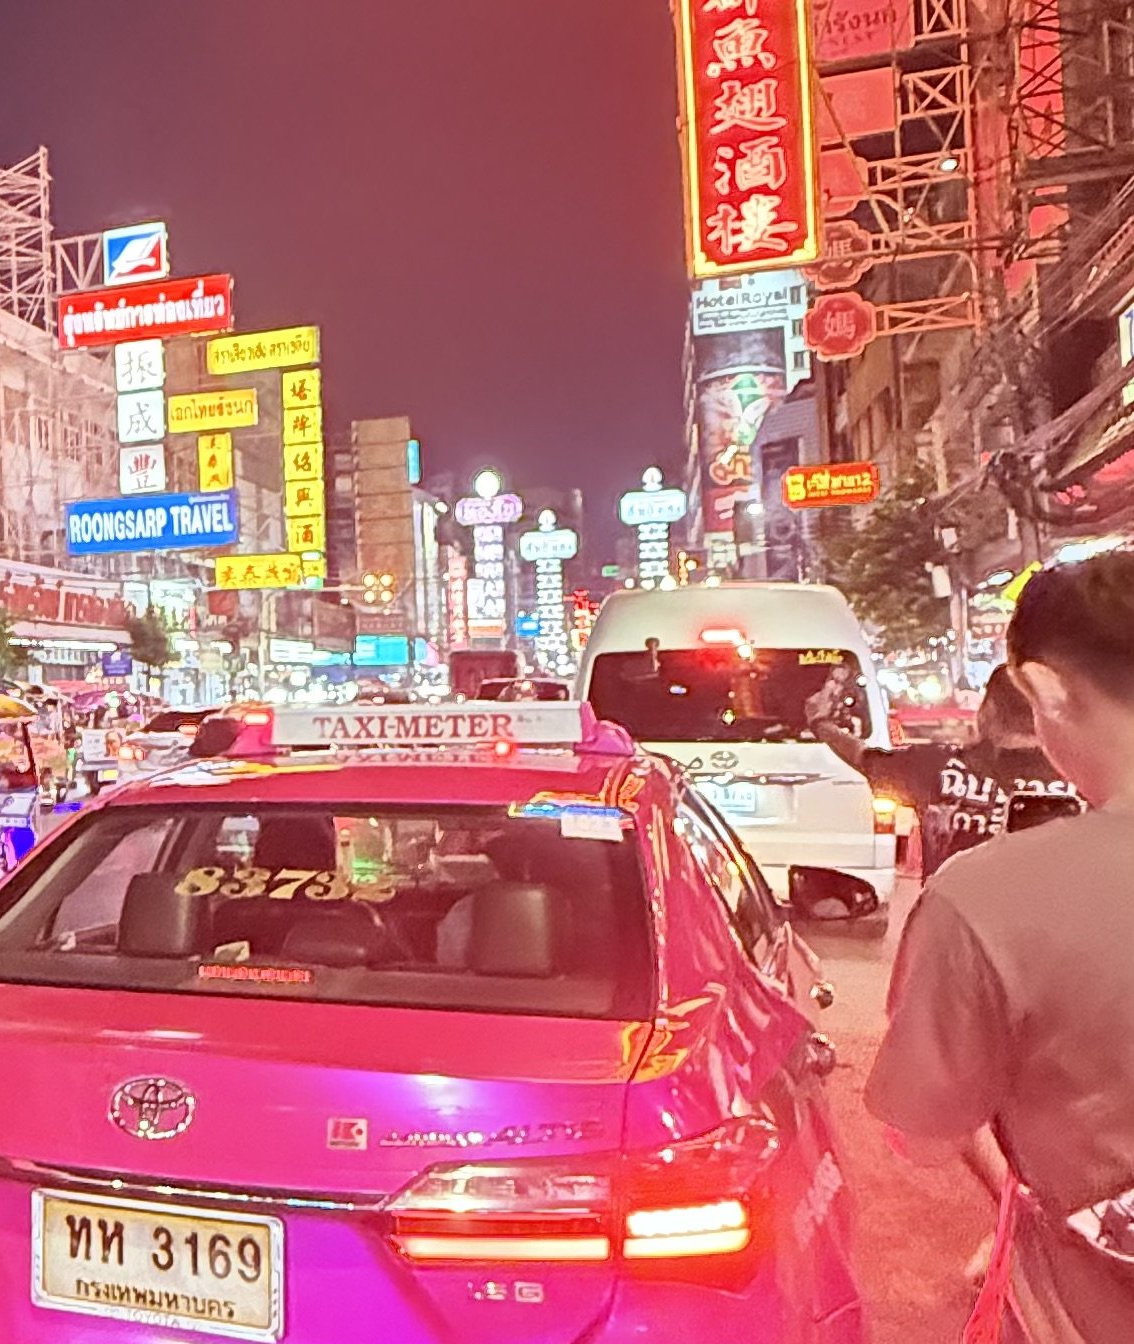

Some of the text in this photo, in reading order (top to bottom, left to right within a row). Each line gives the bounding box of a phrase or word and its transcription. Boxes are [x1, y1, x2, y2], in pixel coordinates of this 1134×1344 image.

[695, 286, 788, 310] Hotel Royal
[69, 502, 235, 544] ROONGSARP TRAVEL
[312, 713, 514, 740] TAXI-METER
[174, 866, 398, 903] 83732
[152, 1226, 261, 1283] 3169
